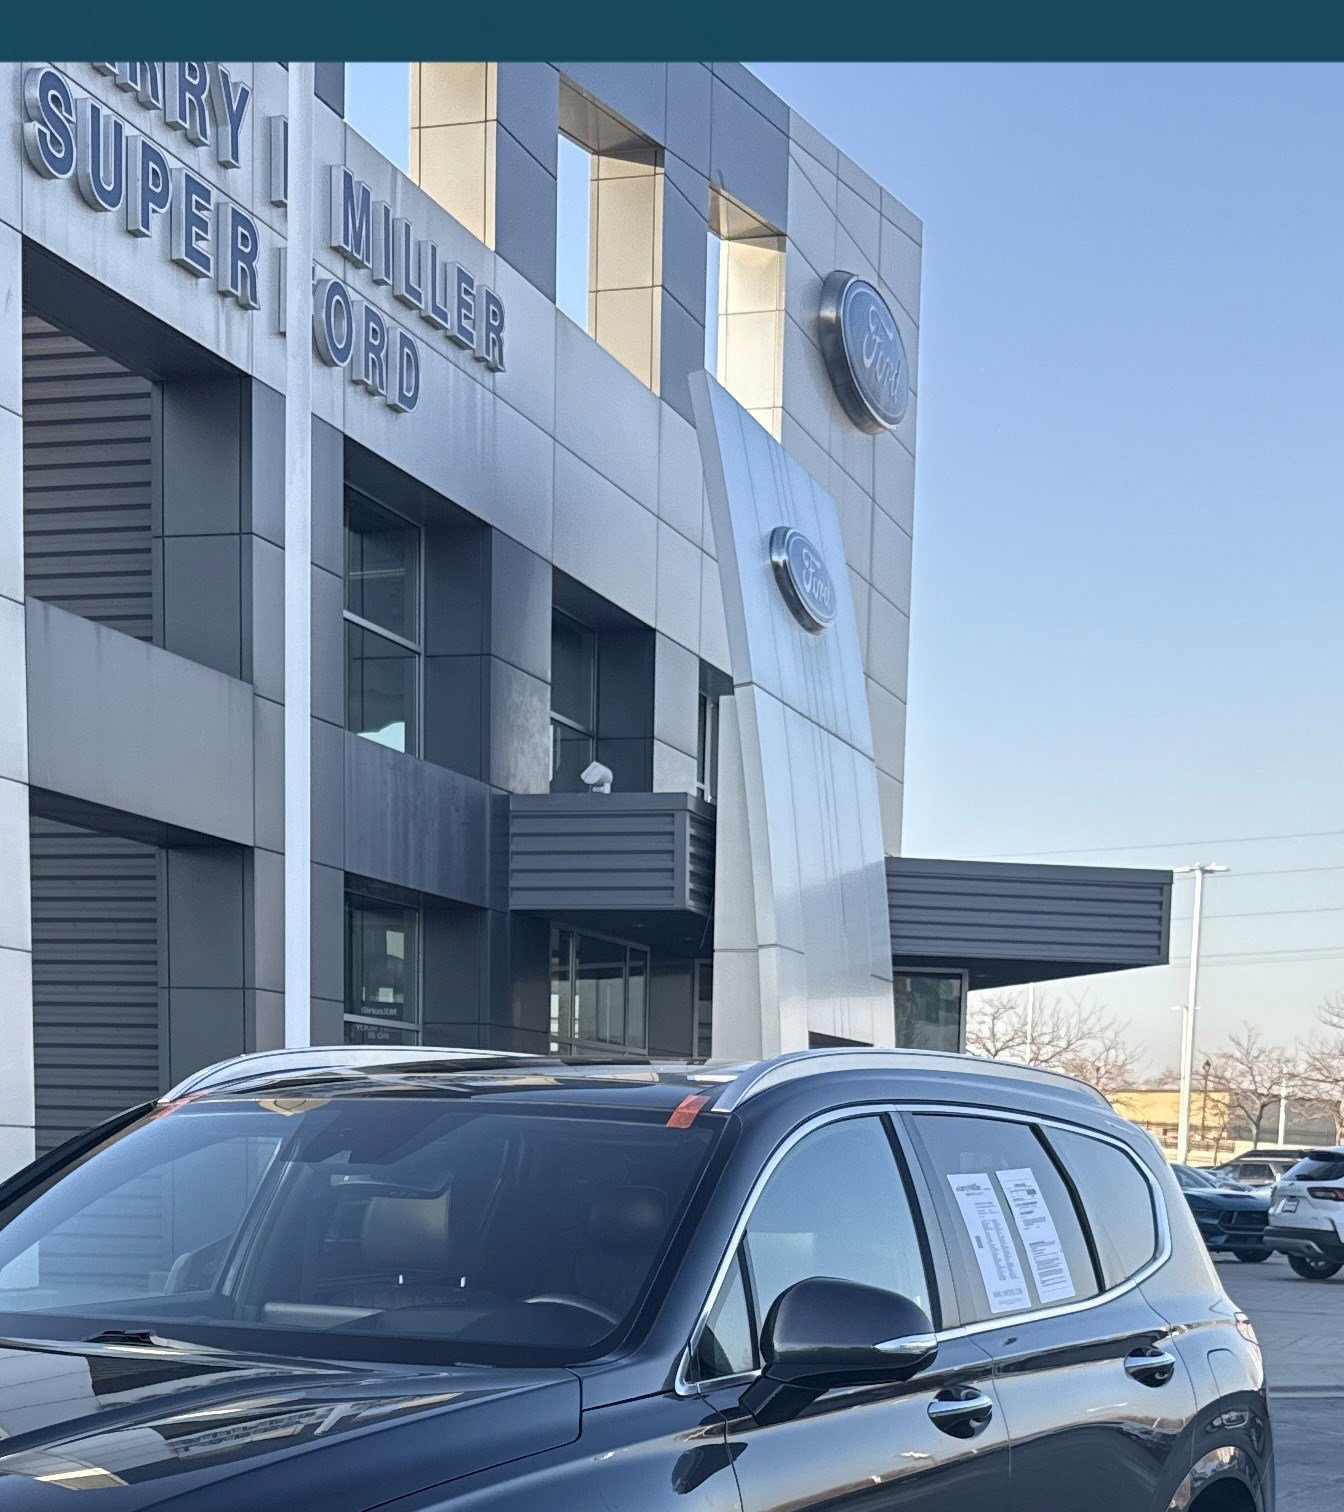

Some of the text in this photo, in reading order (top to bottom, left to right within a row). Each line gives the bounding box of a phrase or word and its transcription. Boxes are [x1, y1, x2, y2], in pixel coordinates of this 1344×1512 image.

[24, 66, 261, 311] SUPER
[279, 247, 421, 414] ORD
[330, 163, 506, 373] MILLER
